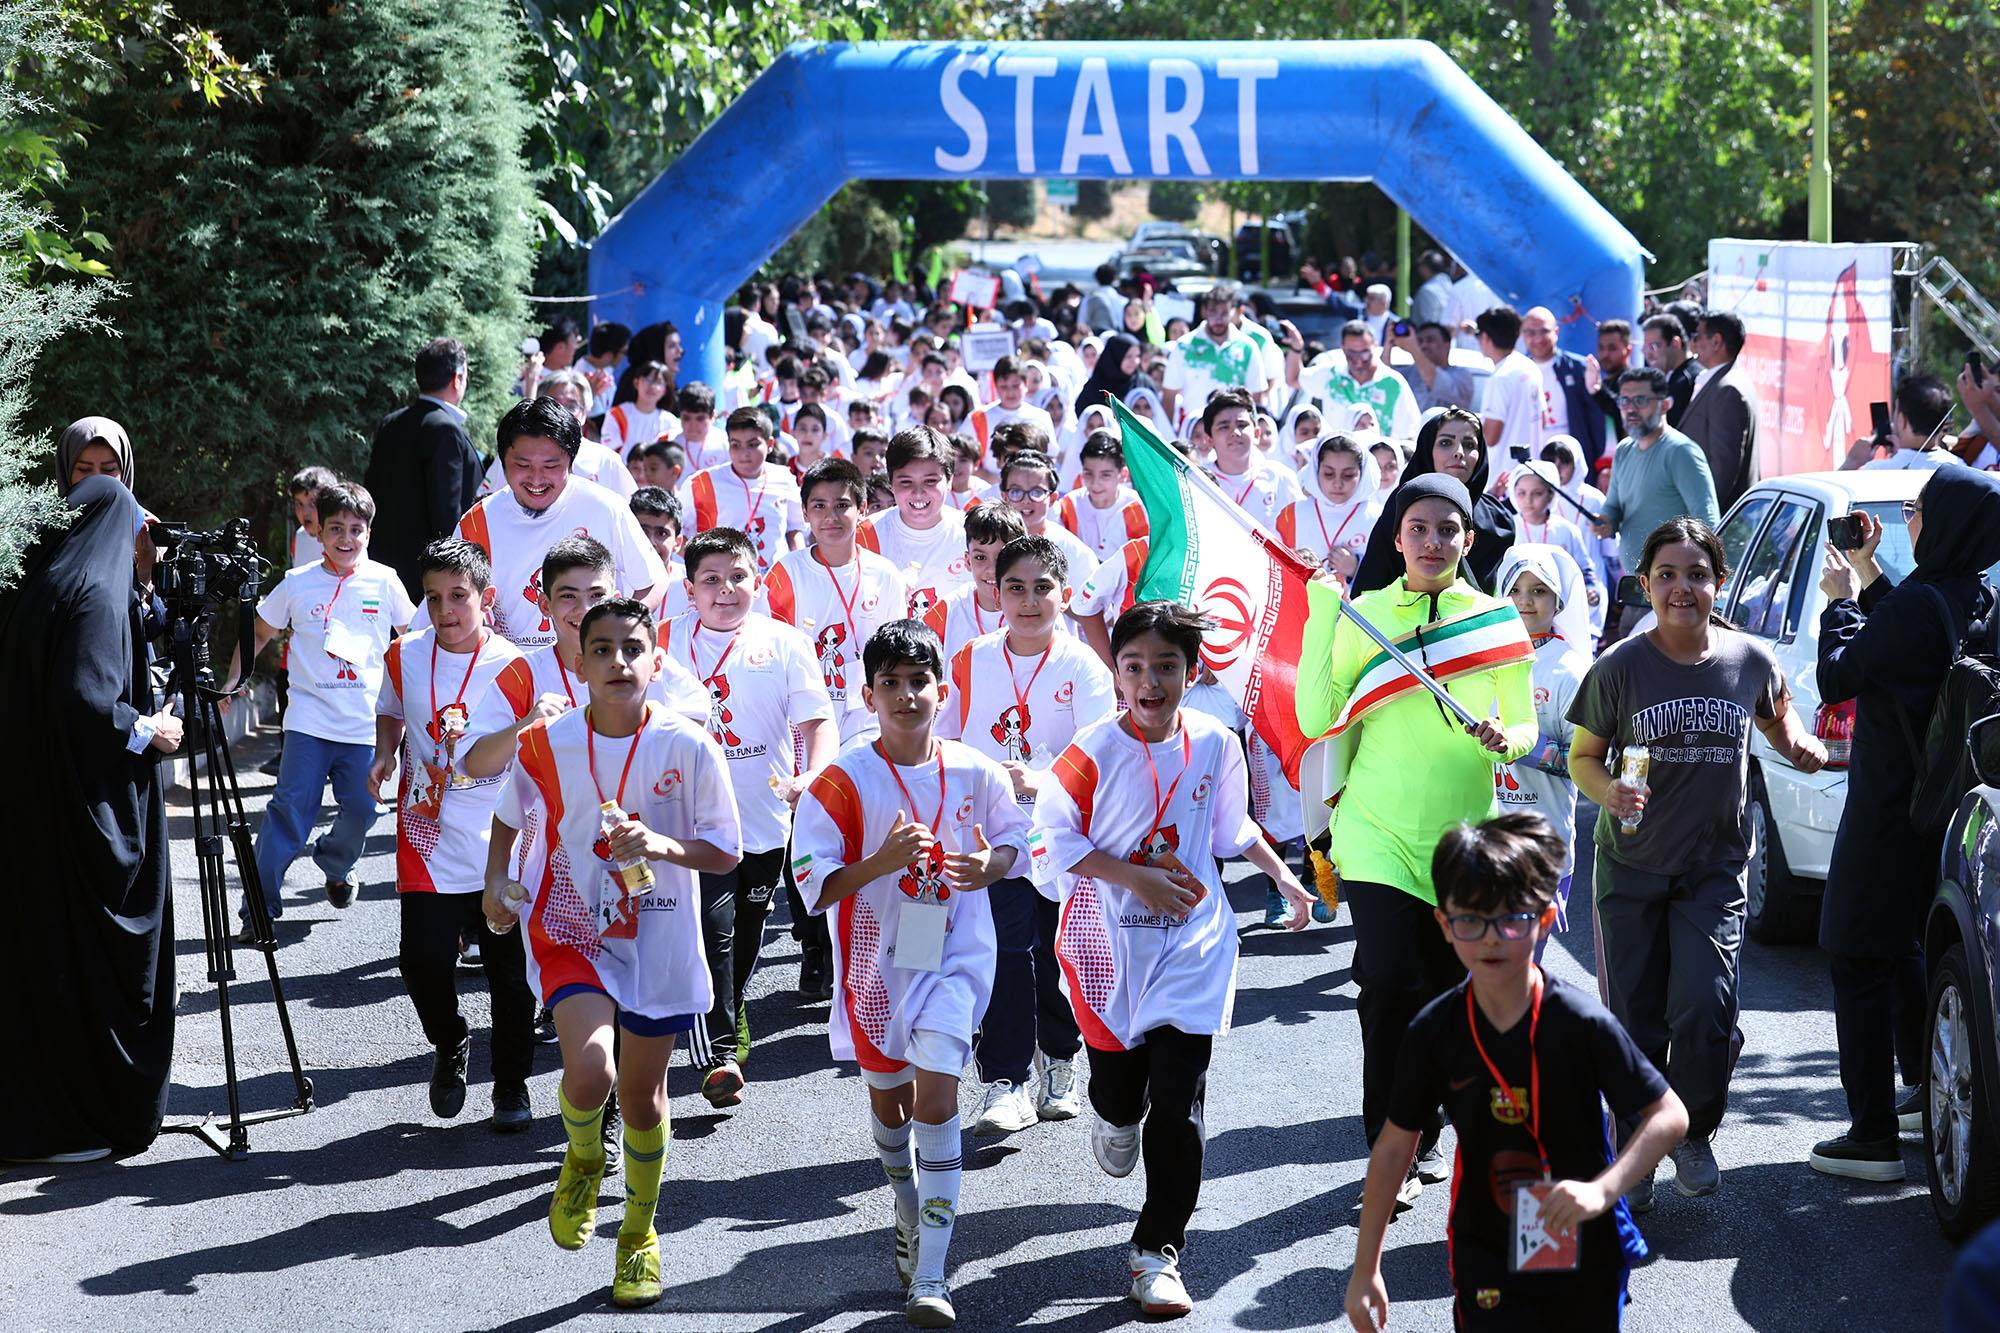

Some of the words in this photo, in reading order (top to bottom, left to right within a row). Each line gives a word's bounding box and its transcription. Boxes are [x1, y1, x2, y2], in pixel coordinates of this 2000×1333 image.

[934, 54, 1280, 176] START
[836, 690, 846, 699] FU
[1684, 734, 1700, 745] OF
[737, 747, 752, 757] FUN
[753, 744, 767, 754] RUN
[1650, 746, 1735, 763] HICHESTER
[1015, 793, 1032, 802] MES
[1507, 792, 1523, 801] FUN
[1524, 793, 1539, 801] RUN
[657, 898, 677, 908] RUN
[1131, 914, 1161, 925] GAMES
